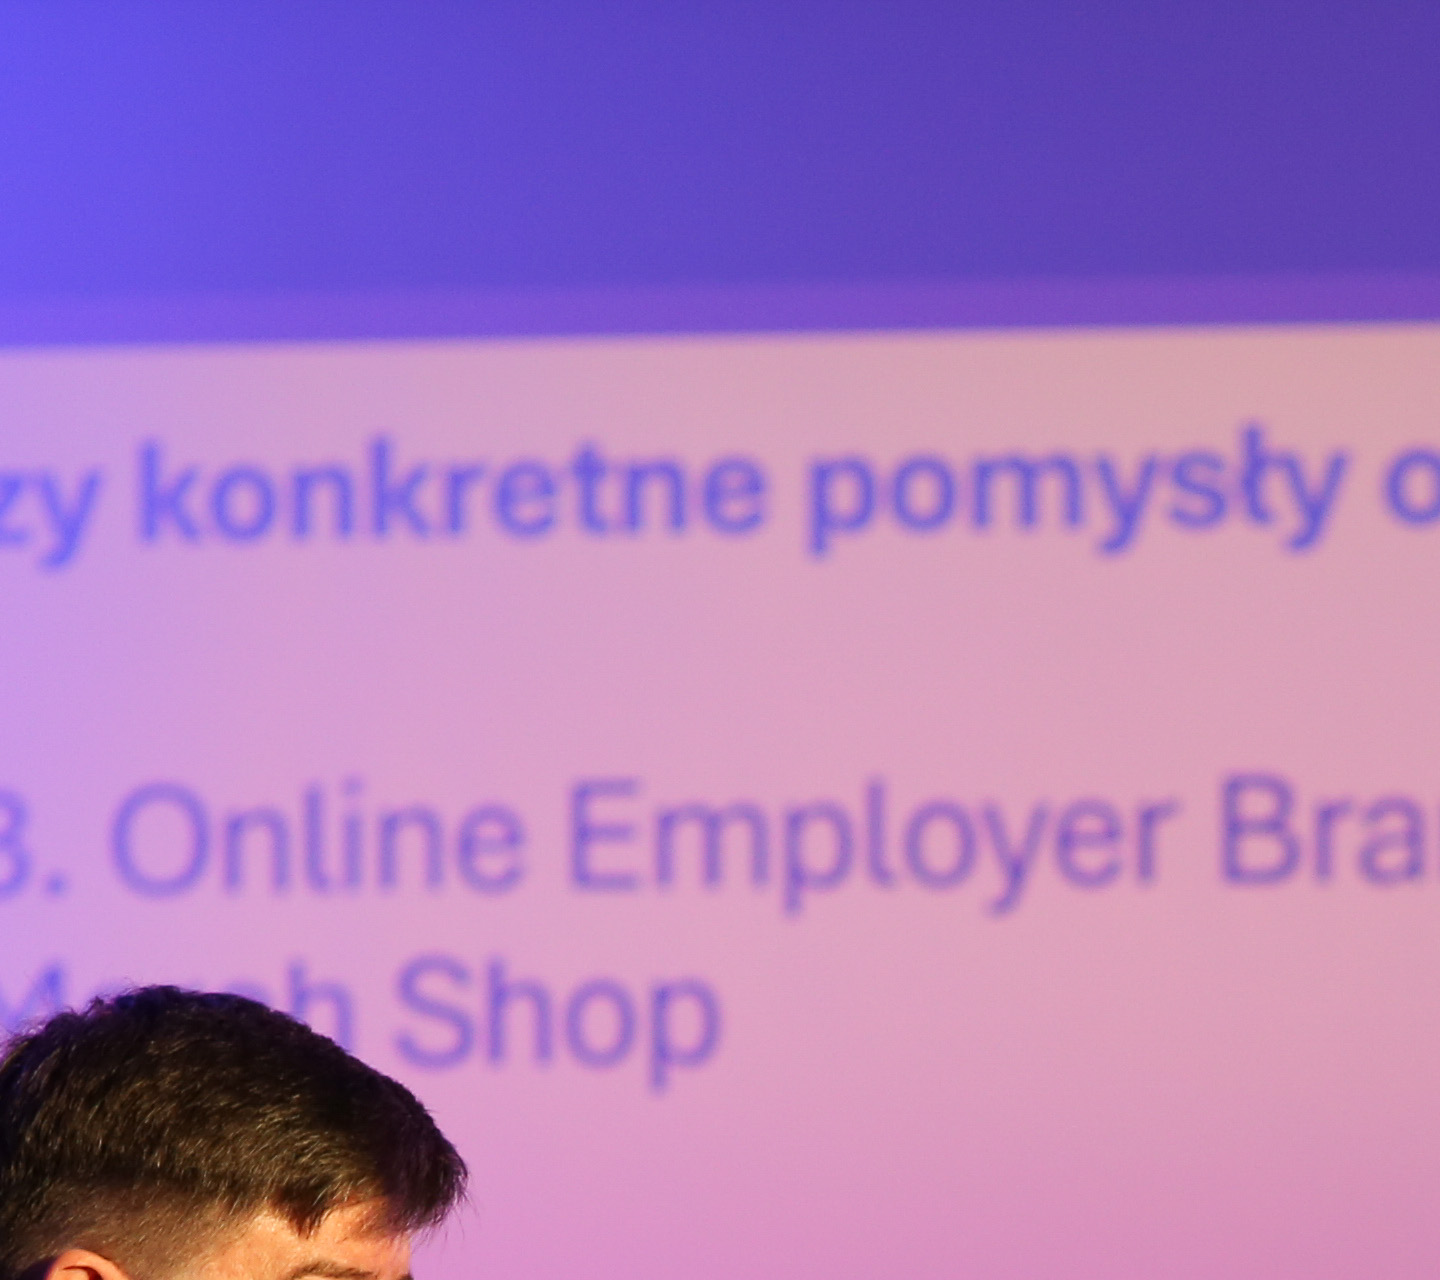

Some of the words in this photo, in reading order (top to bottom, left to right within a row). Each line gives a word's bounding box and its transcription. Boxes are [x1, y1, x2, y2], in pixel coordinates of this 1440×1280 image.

[140, 435, 767, 543] konkretne
[807, 423, 1348, 557] pomysły
[110, 777, 526, 897] Online
[570, 776, 1179, 917] Employer
[394, 955, 723, 1093] Shop
